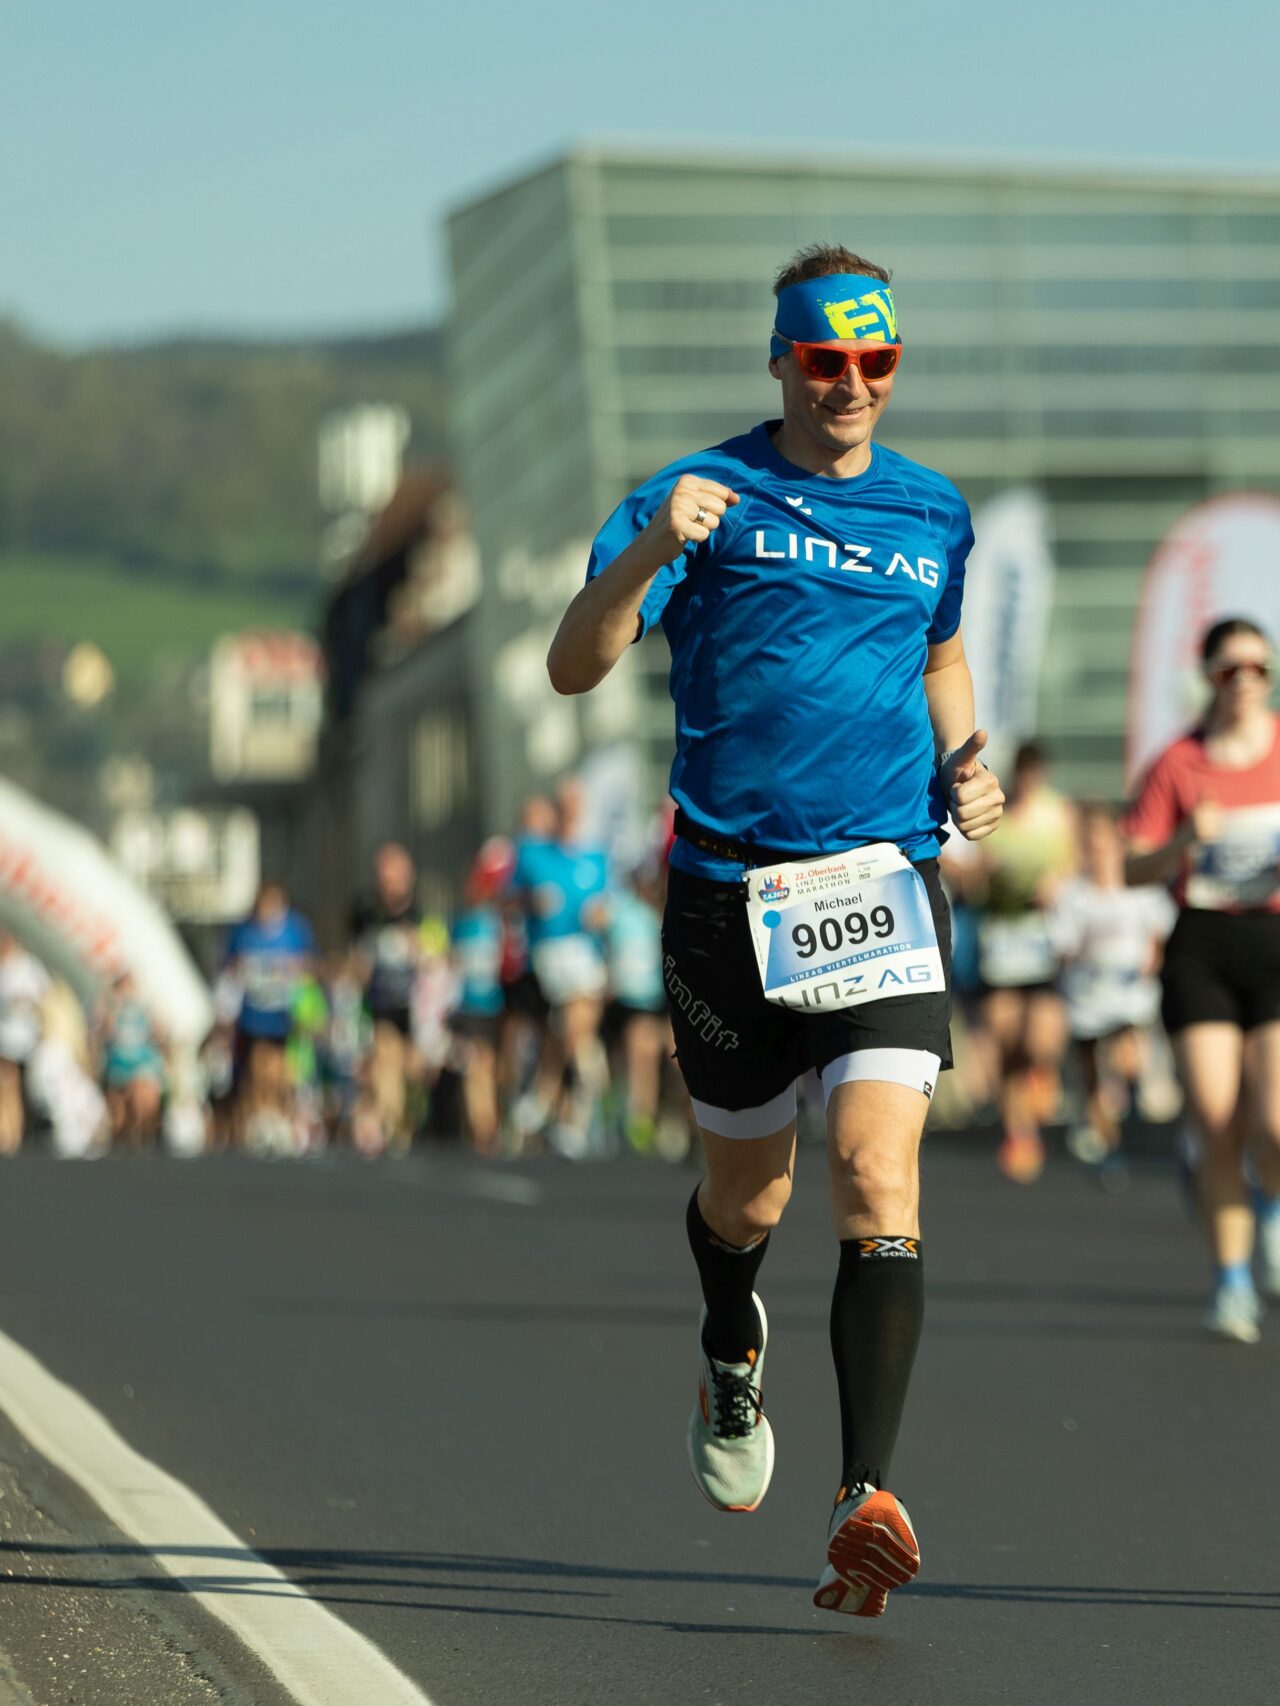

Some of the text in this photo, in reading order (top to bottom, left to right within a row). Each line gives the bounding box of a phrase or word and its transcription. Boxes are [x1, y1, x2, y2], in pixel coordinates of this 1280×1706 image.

[756, 530, 939, 588] LINZ AG
[795, 879, 815, 888] LINZ
[818, 872, 850, 883] DONAU
[808, 863, 847, 878] Oberbank
[797, 879, 851, 895] MARATHON
[814, 893, 863, 912] Michael
[791, 905, 895, 959] 9099
[778, 965, 932, 1009] LINZ AG
